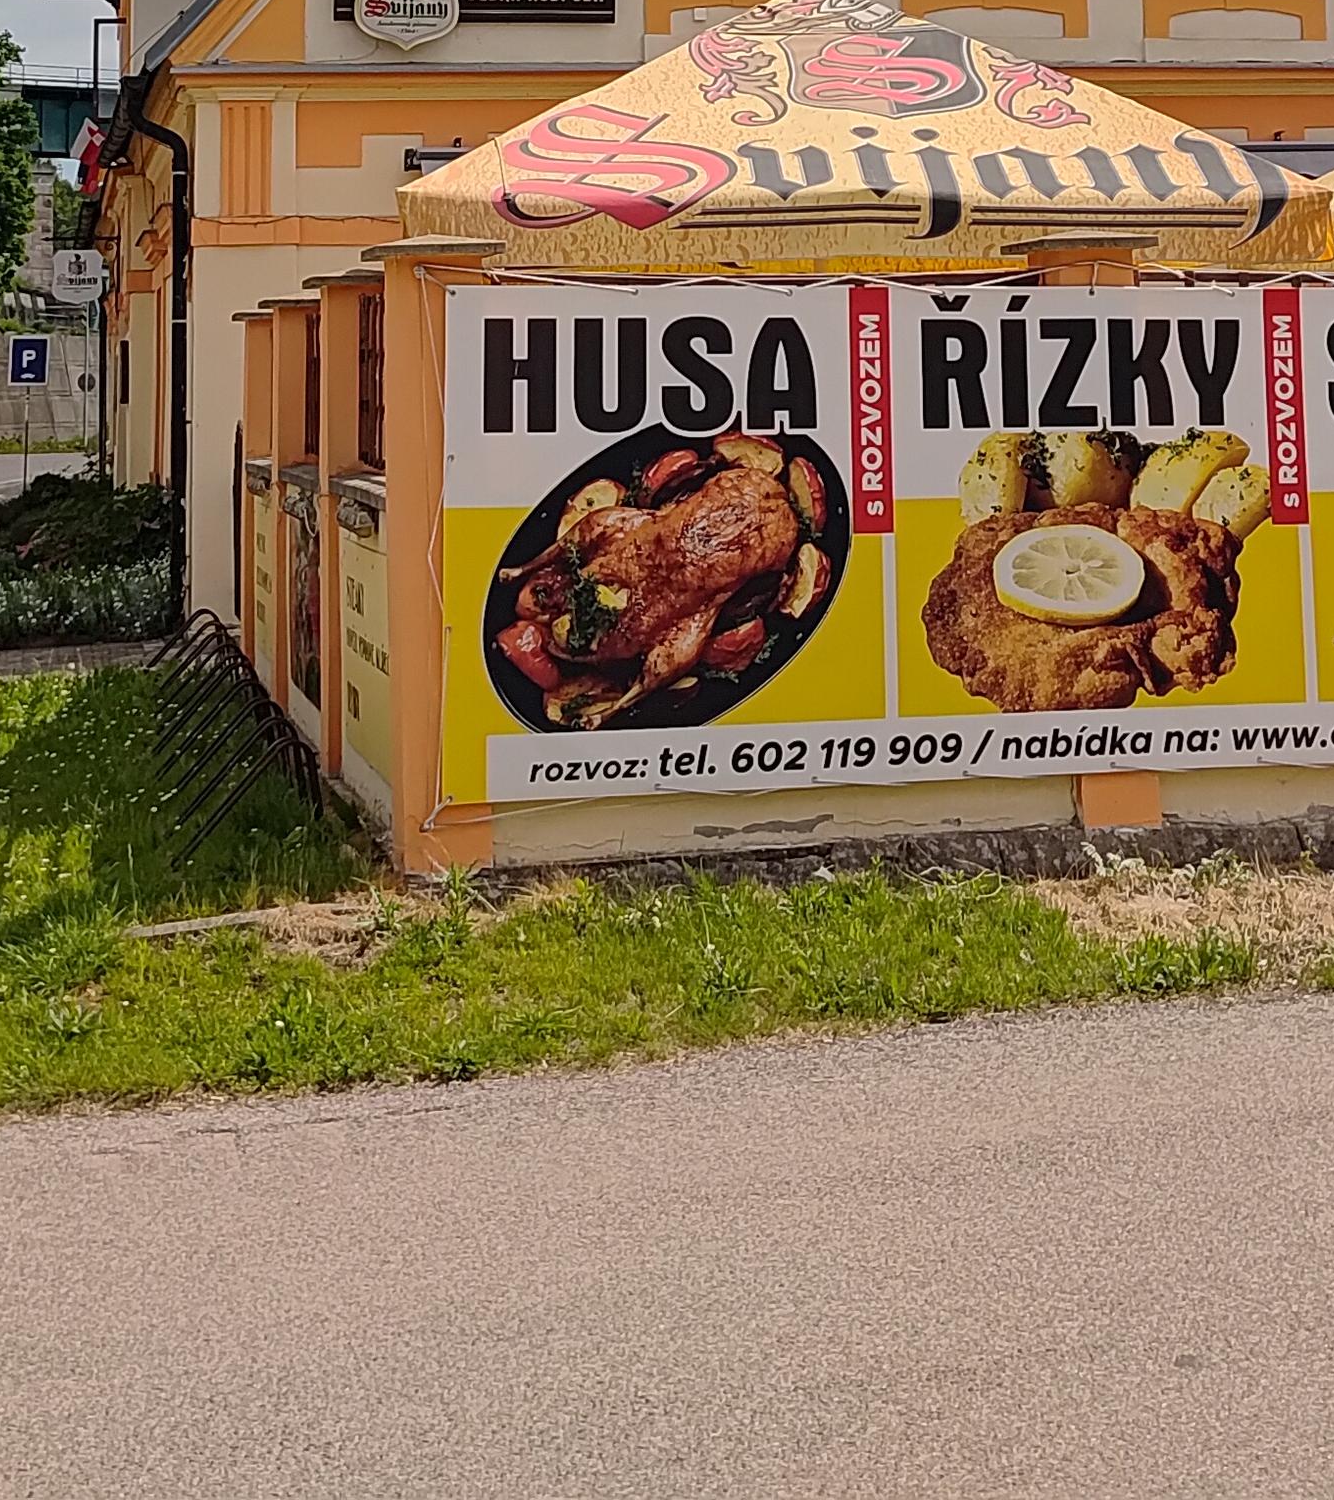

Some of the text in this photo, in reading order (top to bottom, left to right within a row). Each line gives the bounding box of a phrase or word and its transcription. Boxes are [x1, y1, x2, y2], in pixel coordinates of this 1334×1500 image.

[492, 104, 1290, 249] Svijany
[22, 350, 37, 368] P
[483, 315, 818, 433] HUSA
[858, 313, 884, 492] ROZVOZEM
[920, 294, 1240, 430] ŘÍZKY
[1271, 314, 1299, 485] ROZVOZEM
[529, 757, 649, 783] rozvoz:
[659, 745, 717, 777] tel.
[731, 740, 808, 773] 602
[819, 736, 876, 770] 119
[888, 732, 963, 765] 909
[1000, 725, 1152, 760] nabídka
[1163, 728, 1221, 752] na:
